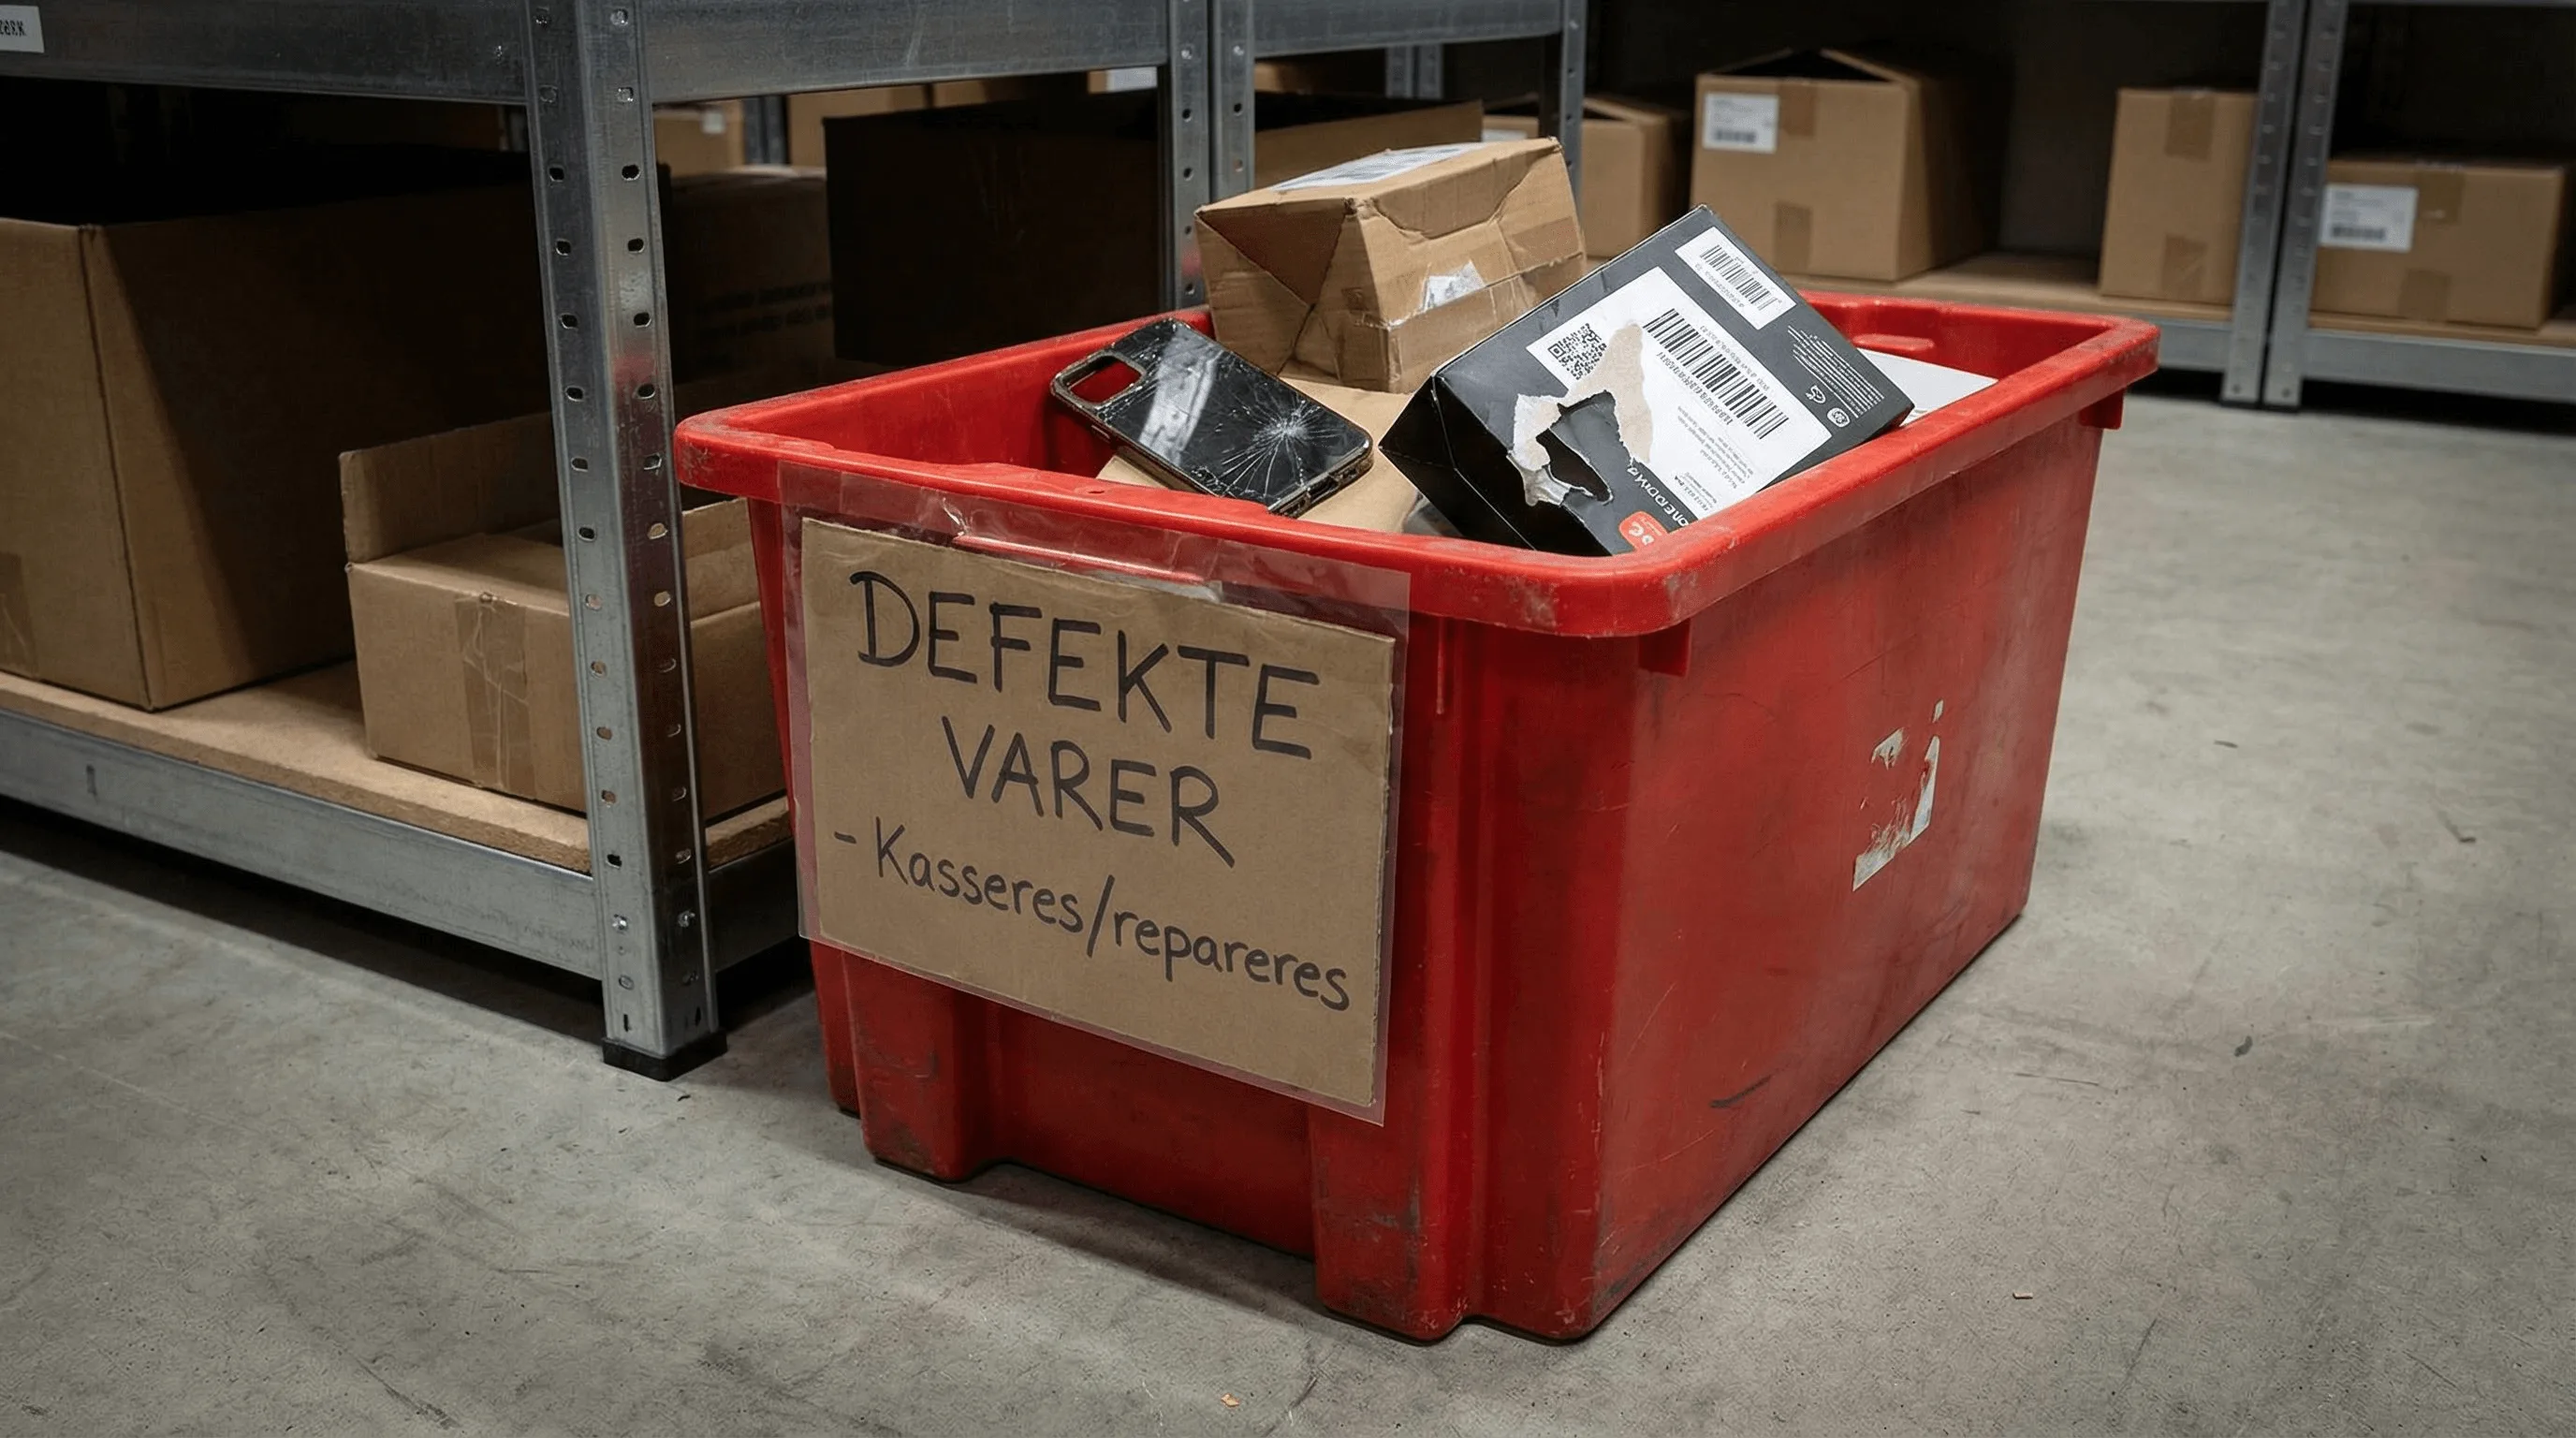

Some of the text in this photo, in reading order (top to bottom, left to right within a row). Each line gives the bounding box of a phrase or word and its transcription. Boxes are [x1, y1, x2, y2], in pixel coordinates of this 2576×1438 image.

[849, 570, 1321, 760] DEFEKTE
[941, 715, 1236, 869] VARER
[875, 815, 1351, 1012] Kasseres/repareres
